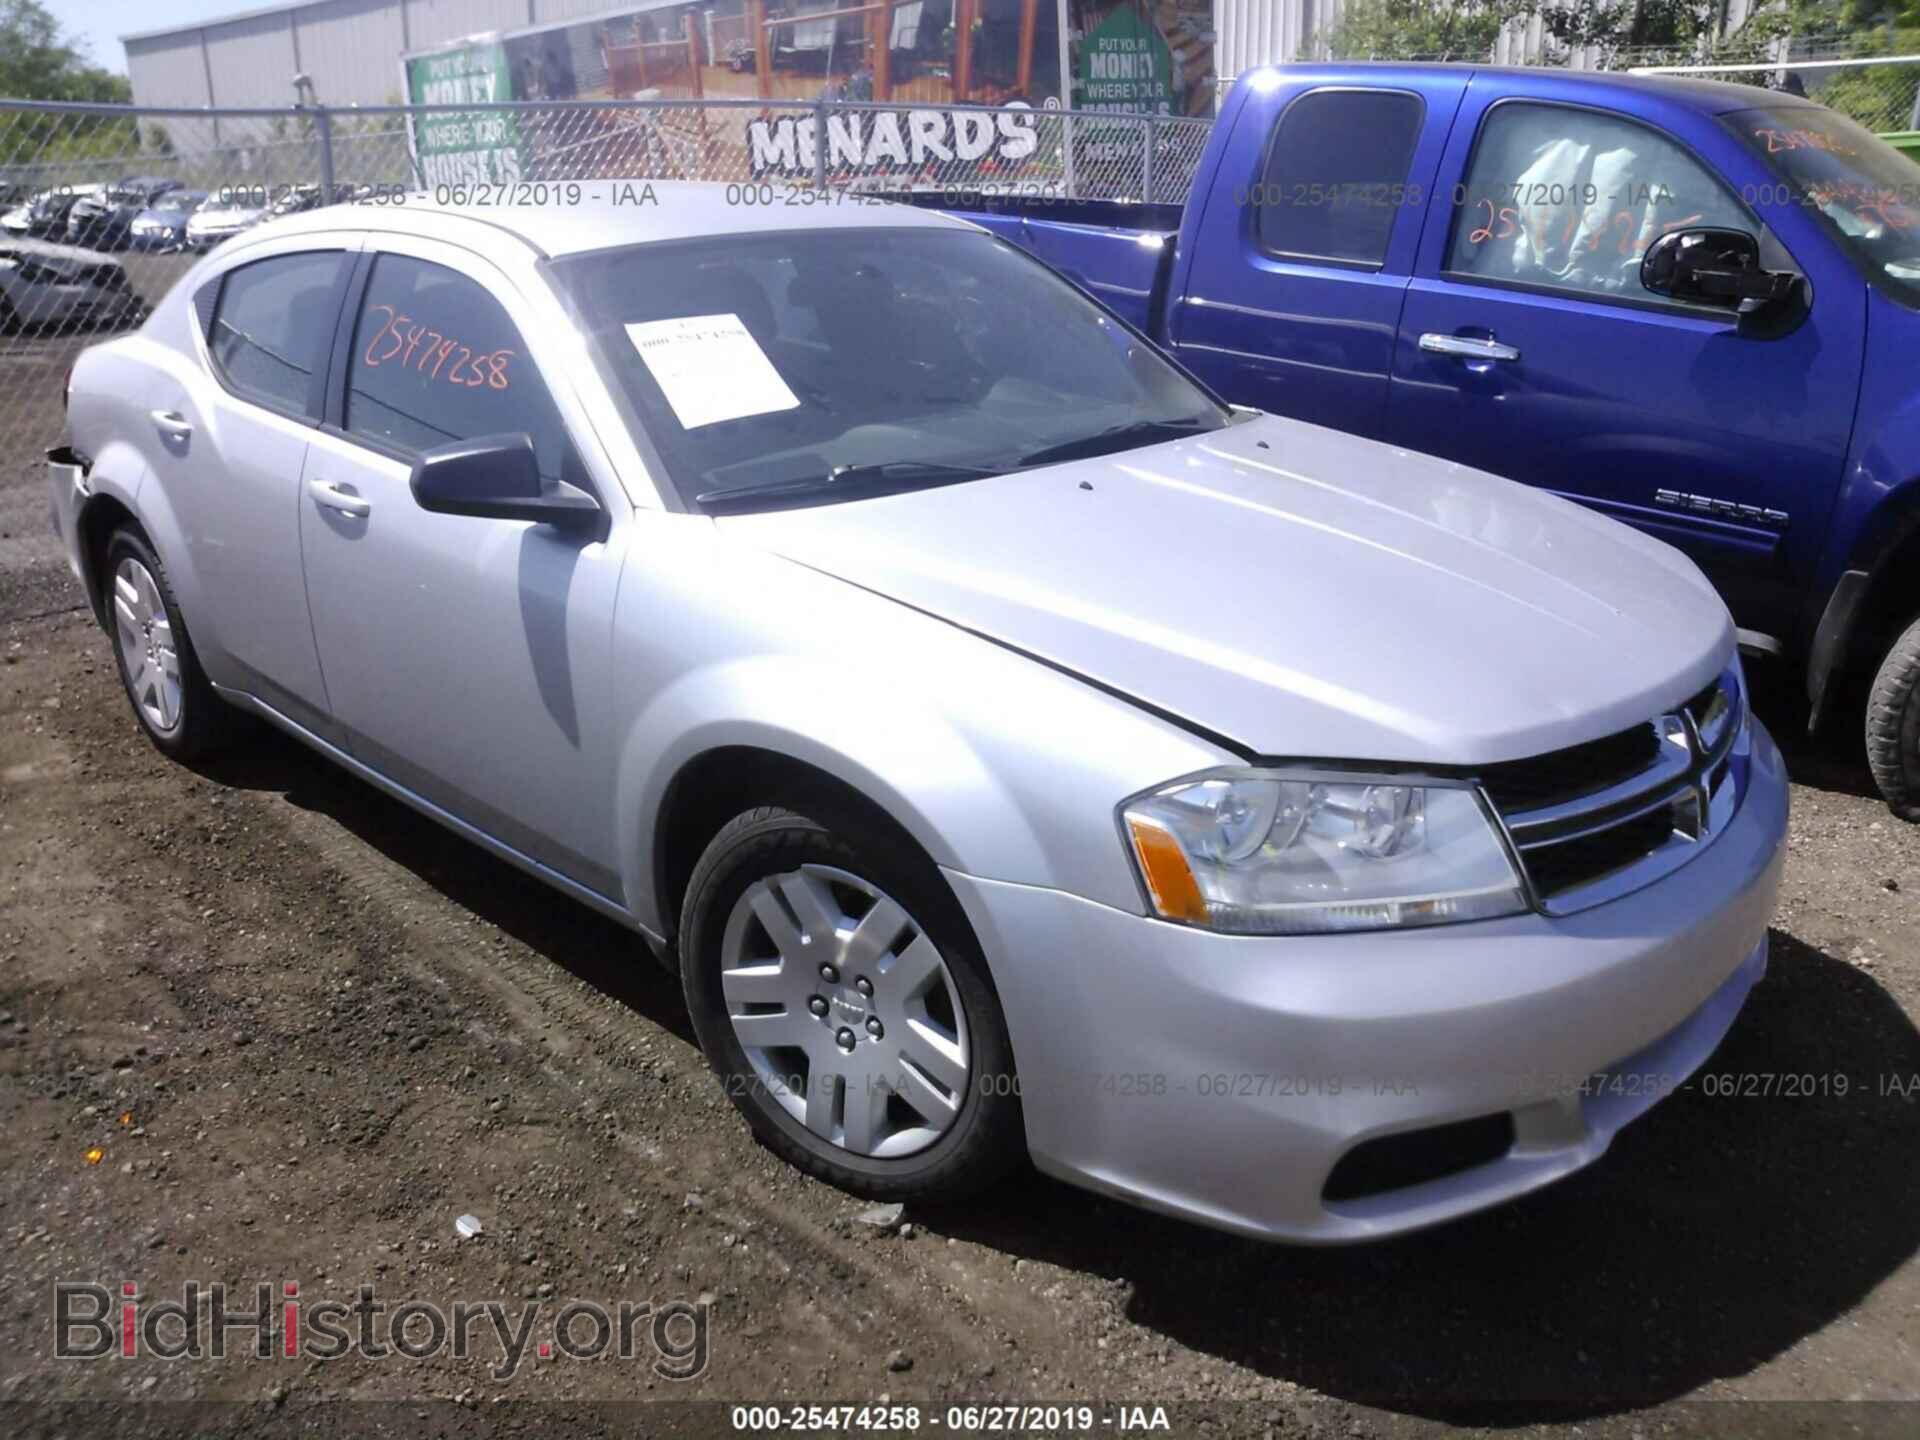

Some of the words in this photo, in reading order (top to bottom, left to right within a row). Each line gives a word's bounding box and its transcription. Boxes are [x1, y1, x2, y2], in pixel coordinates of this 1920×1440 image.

[1099, 38, 1118, 50] PUT
[1087, 83, 1130, 98] WHERE
[750, 101, 1038, 171] MENARDS
[364, 303, 516, 390] 25474258
